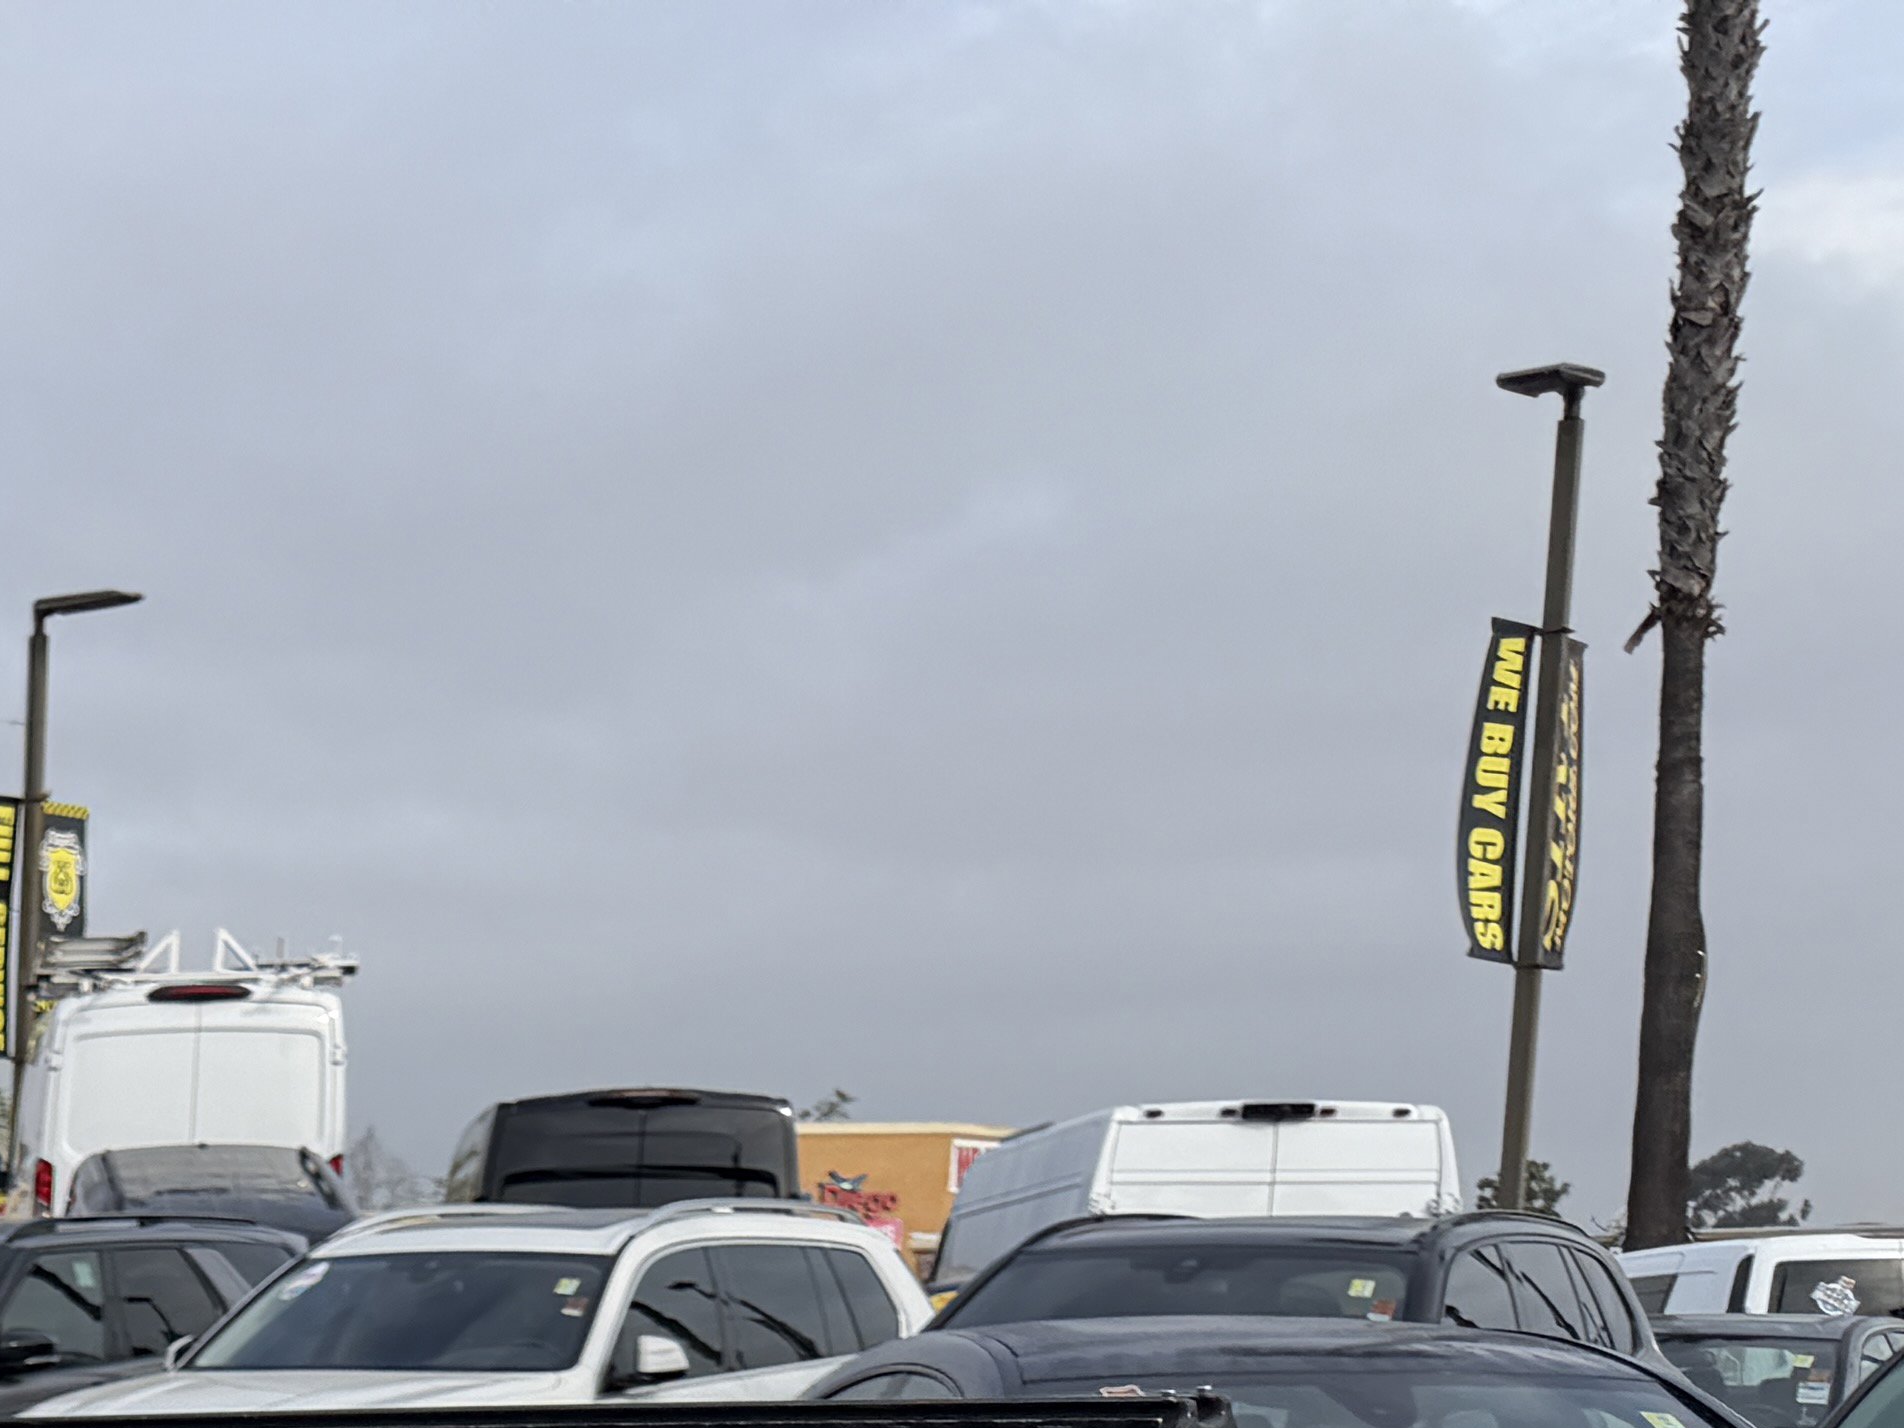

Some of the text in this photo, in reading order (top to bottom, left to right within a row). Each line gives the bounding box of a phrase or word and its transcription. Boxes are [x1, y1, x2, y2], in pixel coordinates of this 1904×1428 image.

[1468, 637, 1526, 952] WE BUY CARS
